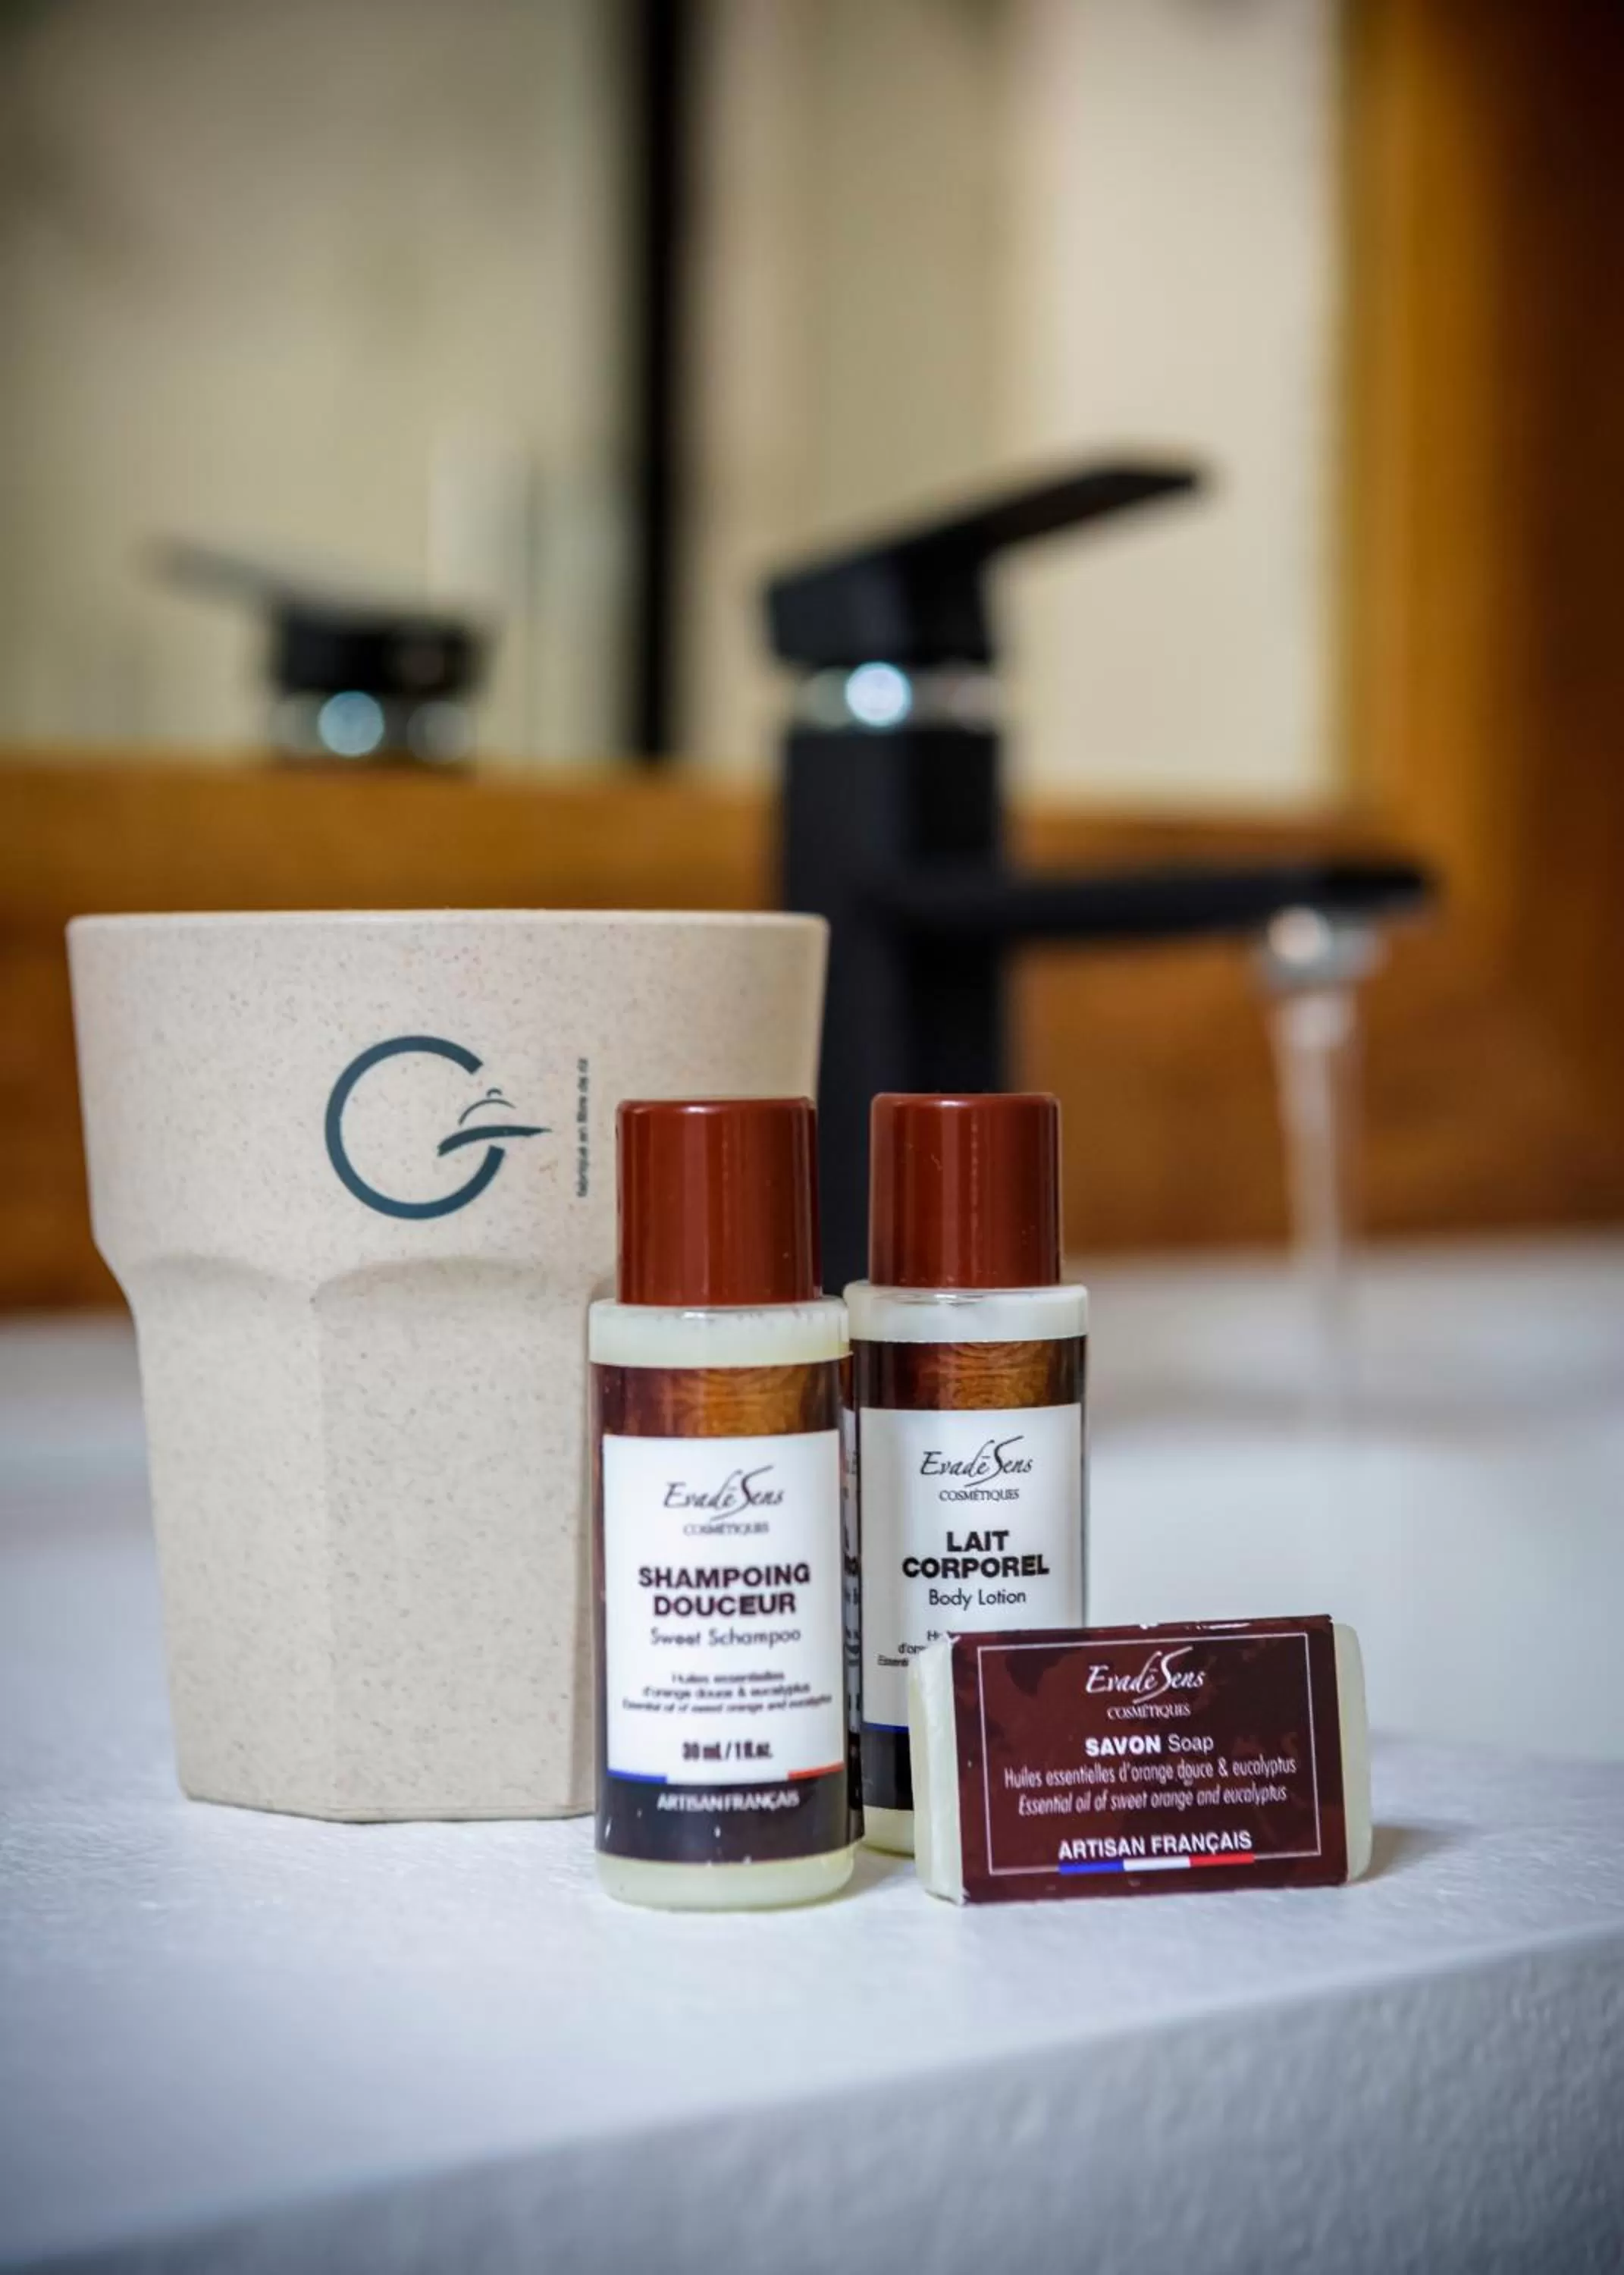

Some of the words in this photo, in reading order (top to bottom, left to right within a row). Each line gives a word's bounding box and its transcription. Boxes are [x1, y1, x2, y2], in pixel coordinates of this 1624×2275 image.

[946, 1530, 1009, 1552] LAIT
[638, 1562, 810, 1589] SHAMPOING
[902, 1555, 1050, 1578] CORPOREL
[654, 1592, 797, 1617] DOUCEUR
[929, 1588, 973, 1611] Body
[978, 1589, 1027, 1606] Lotion
[650, 1627, 701, 1646] Sweet
[708, 1626, 801, 1649] Schampoo
[1085, 1734, 1162, 1757] SAVON
[1168, 1733, 1214, 1756] Soap
[1004, 1764, 1042, 1789] Huiles
[1046, 1762, 1116, 1787] essentielles
[1118, 1760, 1174, 1784] d'orange
[1177, 1757, 1214, 1787] douce
[1218, 1756, 1229, 1778] &
[1232, 1753, 1297, 1778] eucalyptus
[1018, 1792, 1074, 1816] Essential
[1075, 1790, 1092, 1813] oil
[1094, 1788, 1109, 1812] of
[1110, 1790, 1148, 1811] sweet
[1150, 1790, 1194, 1812] orange
[1196, 1784, 1221, 1806] and
[1223, 1780, 1288, 1806] eucalyptus
[1058, 1836, 1146, 1860] ARTISAN
[1150, 1830, 1252, 1855] FRANÇAIS
